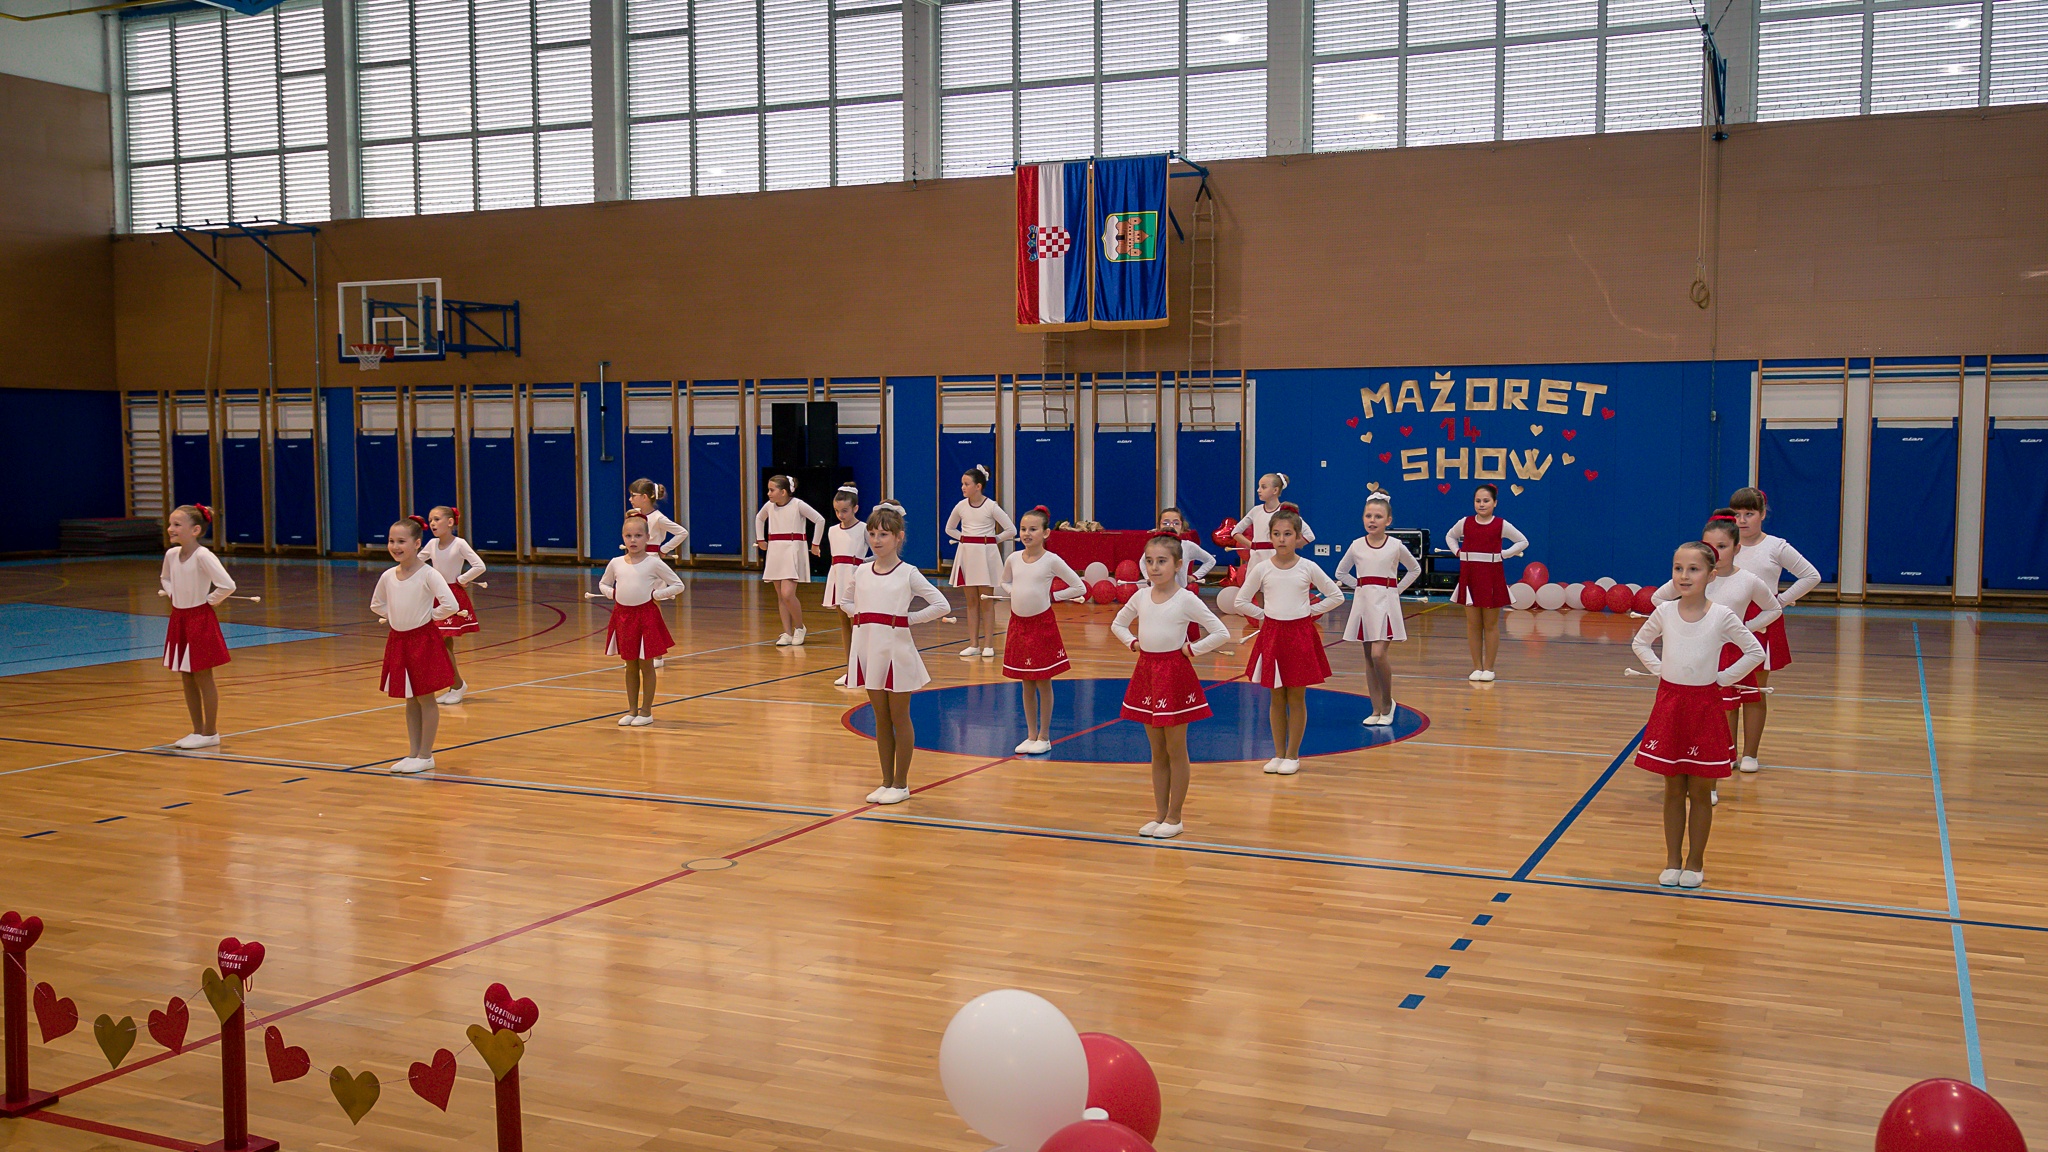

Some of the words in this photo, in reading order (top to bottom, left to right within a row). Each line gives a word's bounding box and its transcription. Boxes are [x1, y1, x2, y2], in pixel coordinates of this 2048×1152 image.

[1360, 371, 1607, 418] MAŽORET
[1440, 416, 1481, 443] 14
[1401, 447, 1553, 481] SHOW
[1142, 695, 1152, 705] K
[1155, 698, 1167, 709] K
[1185, 692, 1196, 704] K
[1645, 740, 1659, 750] K
[1687, 746, 1699, 756] K
